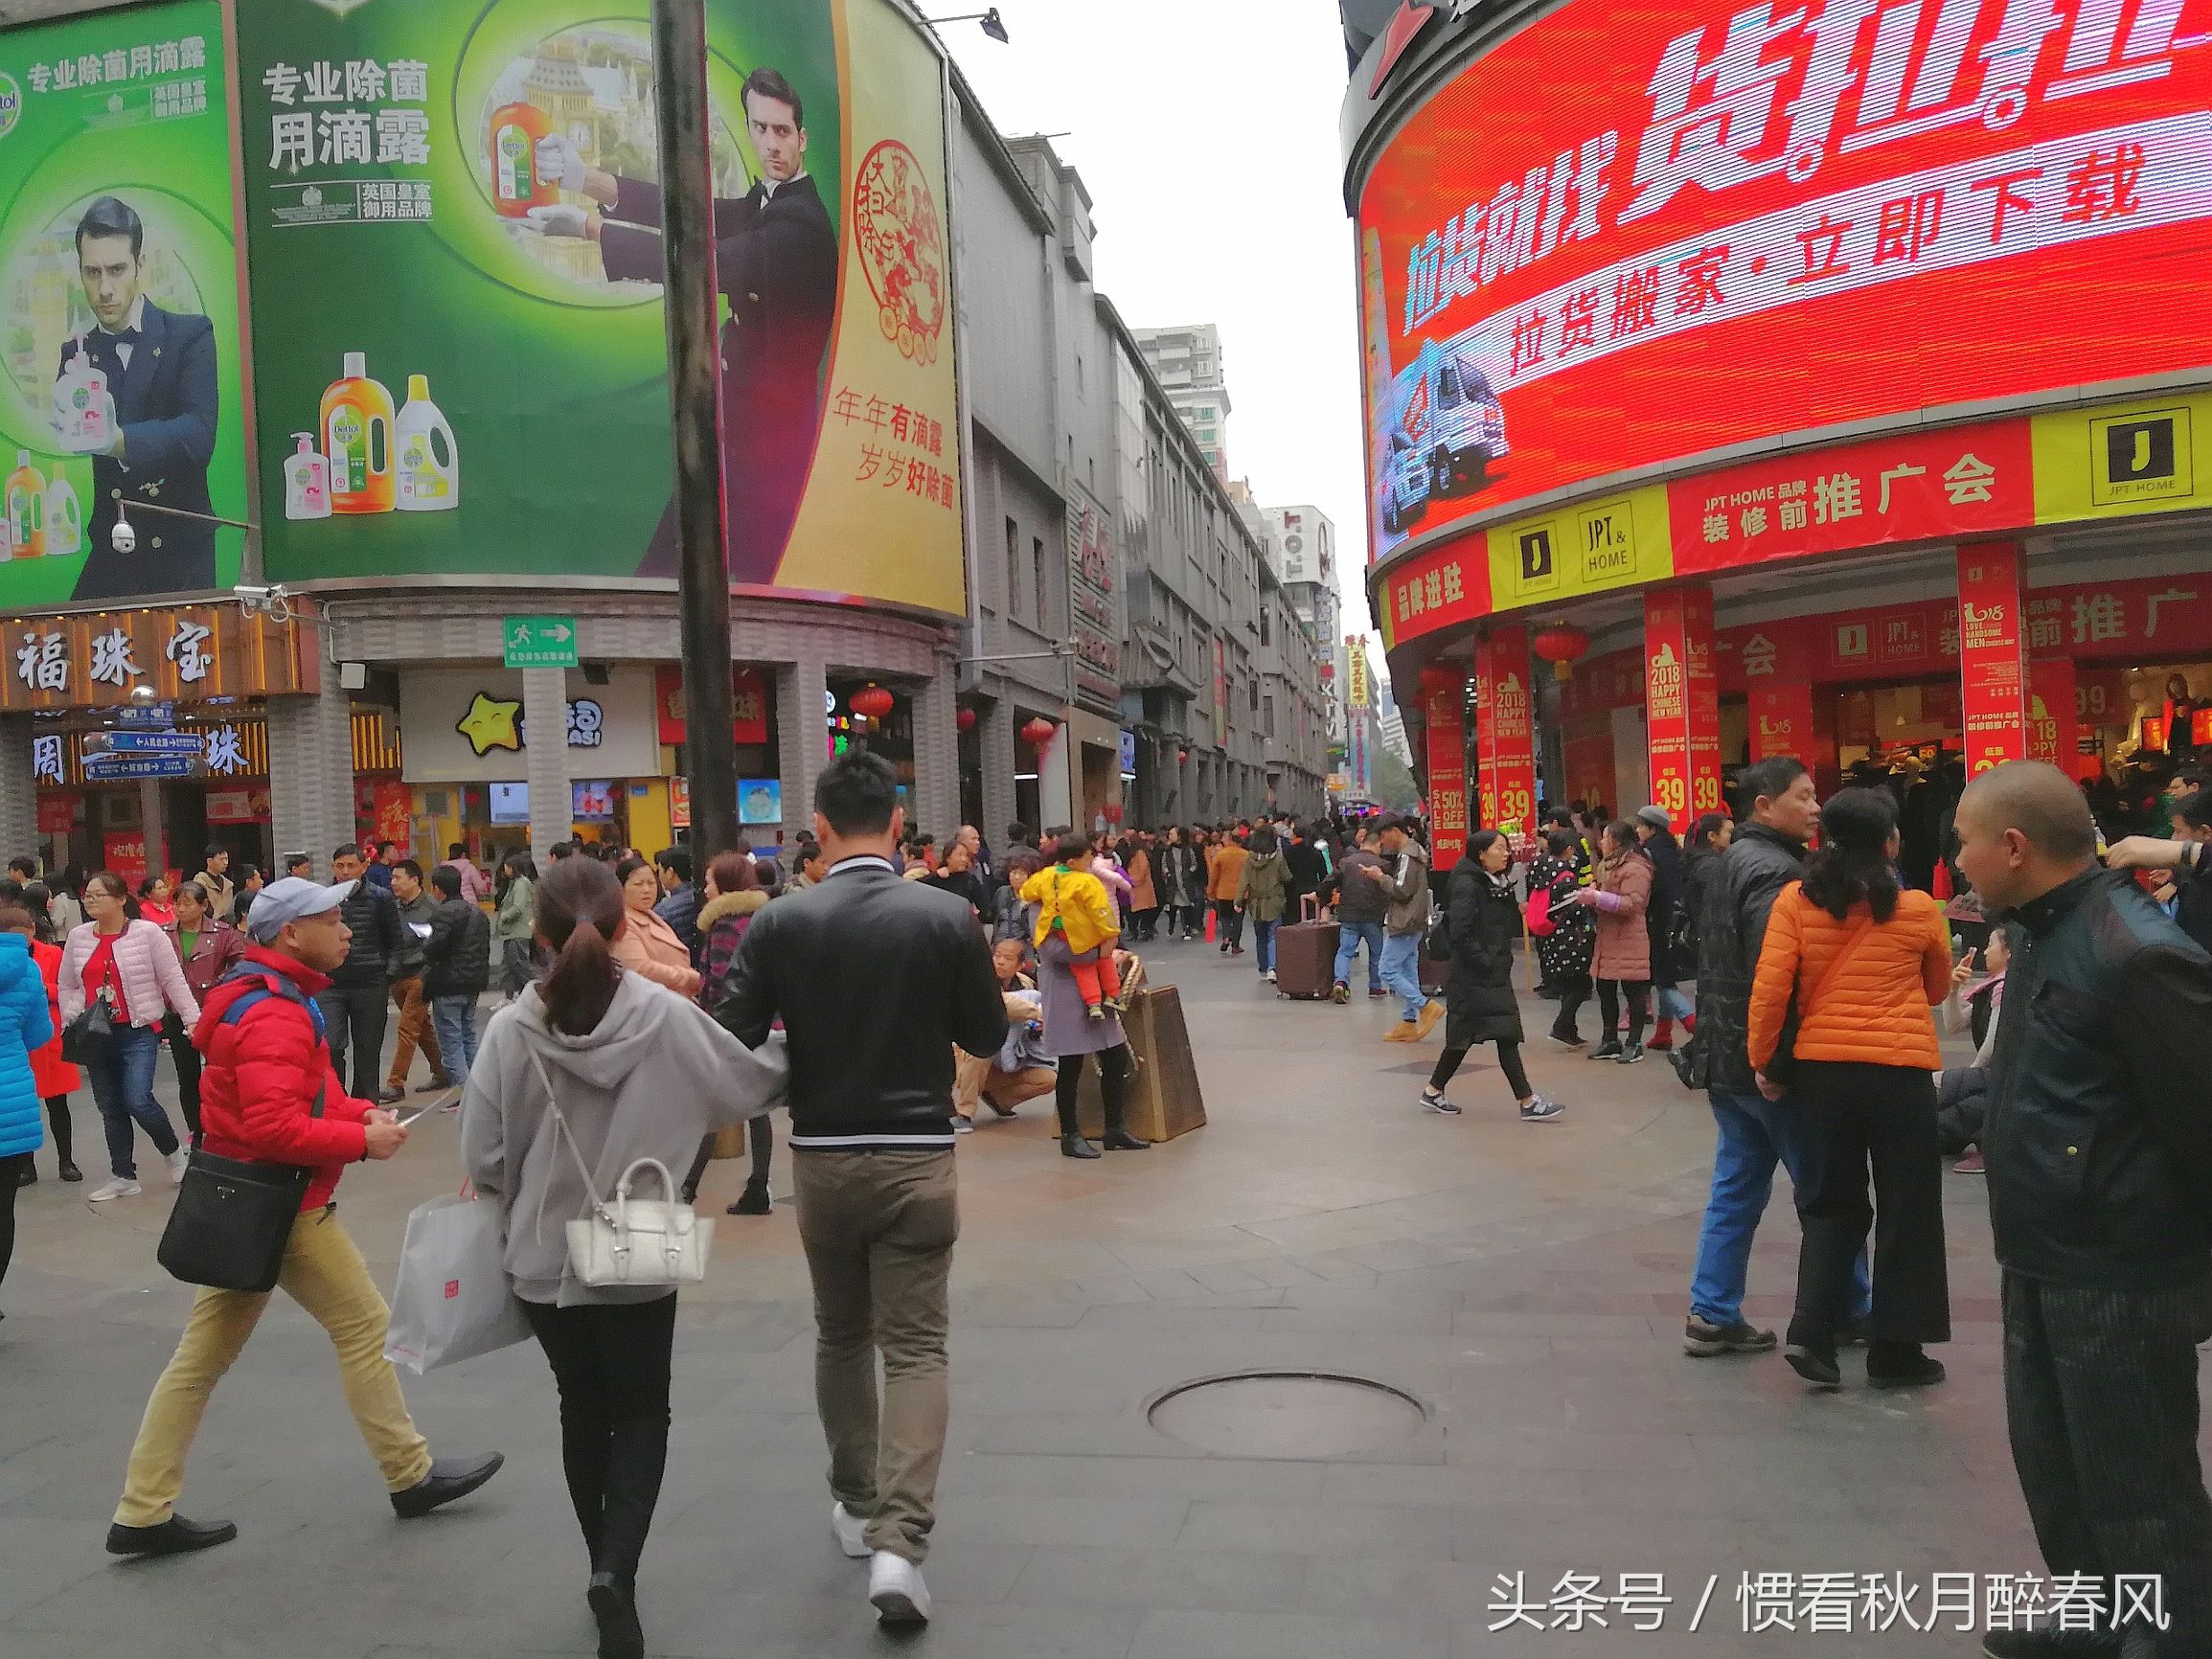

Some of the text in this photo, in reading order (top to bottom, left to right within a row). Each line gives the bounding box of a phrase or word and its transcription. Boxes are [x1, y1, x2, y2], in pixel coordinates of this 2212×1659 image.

[27, 35, 206, 93] 专业除菌用滴露
[262, 58, 429, 105] 专业除菌
[268, 109, 430, 170] 用滴露
[362, 183, 431, 201] 英国皇室
[362, 200, 432, 218] 御用品牌
[832, 385, 944, 458] 年年有滴露
[856, 443, 955, 511] 岁岁好除菌
[1702, 452, 1995, 544] 装修前 推广会
[1704, 480, 1807, 511] JPT HOME 品牌
[2109, 480, 2176, 496] JPT HOME
[1587, 515, 1612, 551] JPT
[1588, 550, 1629, 572] HOME
[1398, 560, 1464, 622] 品牌进驻
[1966, 622, 1983, 631] LOVE
[1966, 627, 2002, 639] HANDSOME
[1967, 638, 1986, 649] MEN
[16, 622, 214, 692] 福珠宝
[1652, 665, 1680, 686] 2018
[1496, 693, 1527, 709] 2018
[1652, 683, 1681, 698] HAPPY
[1653, 696, 1681, 710] CHINESE
[1653, 707, 1666, 718] NEW
[1497, 708, 1527, 720] HAPPY
[1442, 791, 1464, 810] 50%
[1655, 777, 1686, 810] 39
[1695, 777, 1719, 809] 39
[1501, 790, 1530, 819] 39
[1442, 810, 1464, 822] OFF
